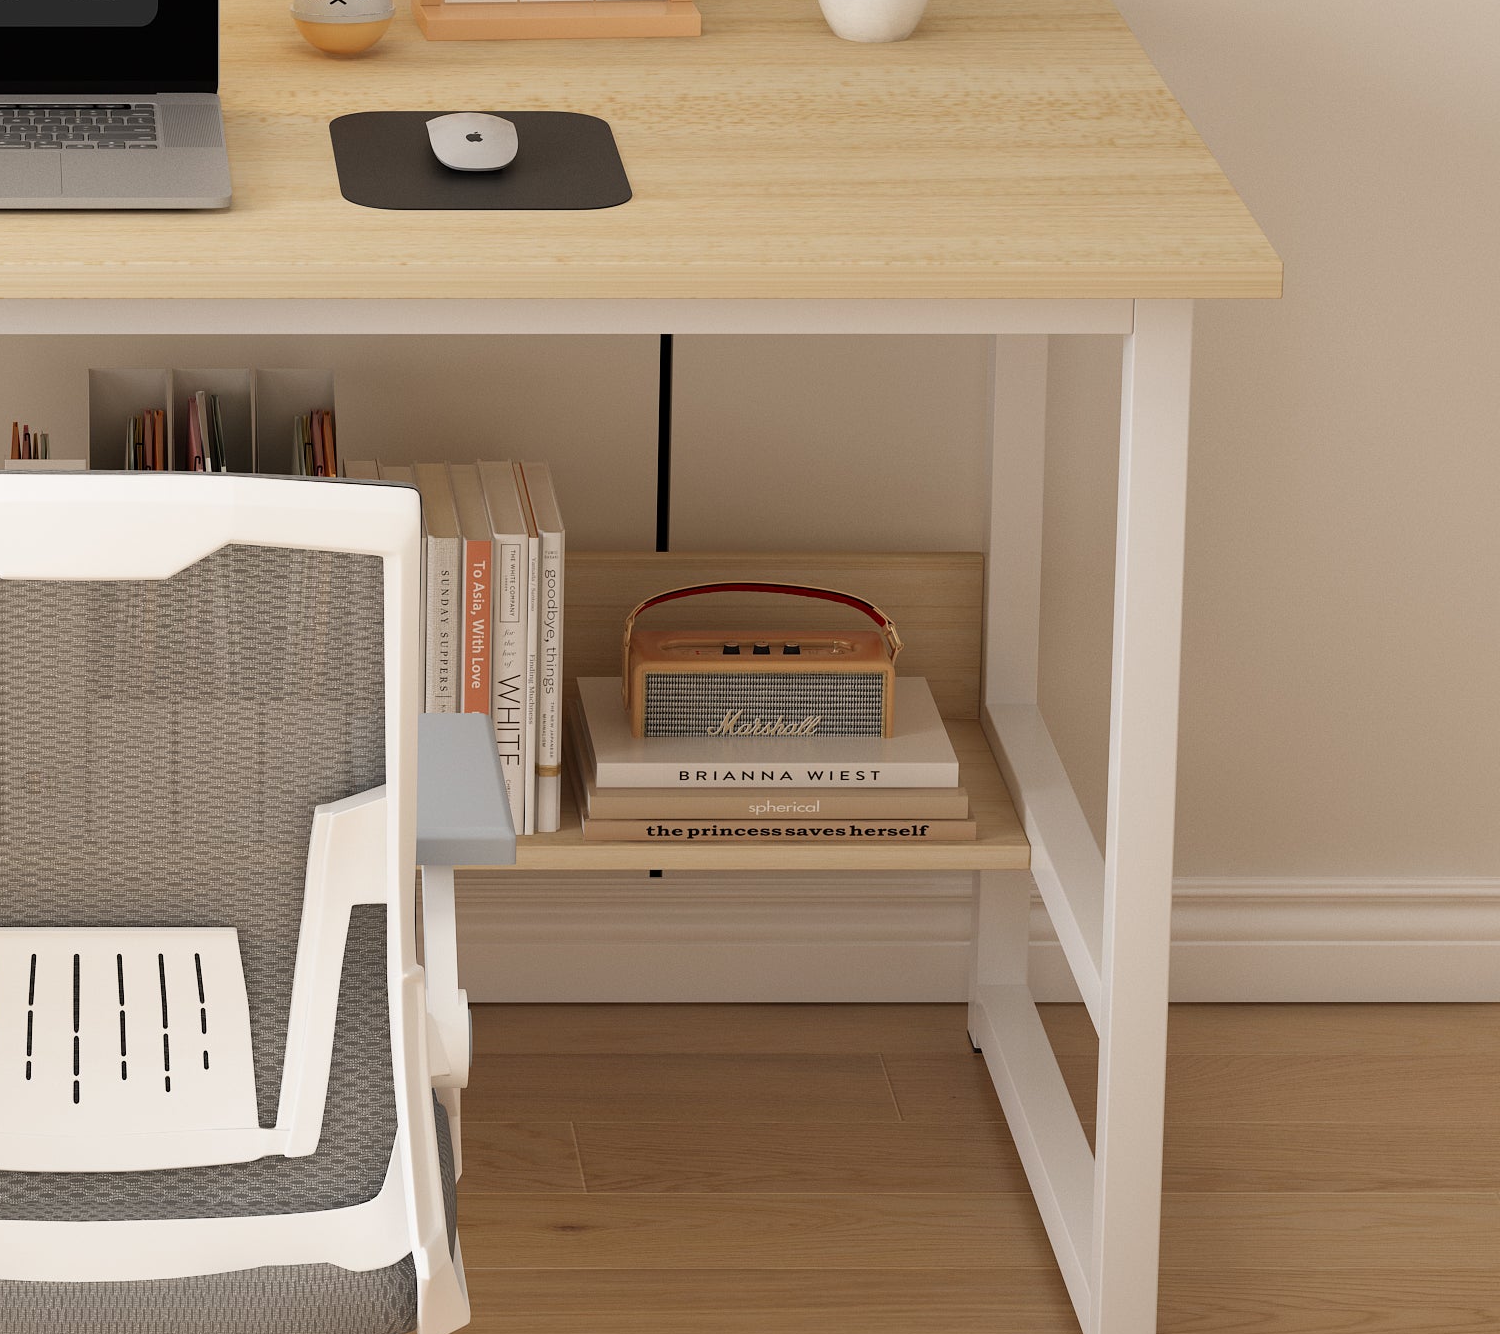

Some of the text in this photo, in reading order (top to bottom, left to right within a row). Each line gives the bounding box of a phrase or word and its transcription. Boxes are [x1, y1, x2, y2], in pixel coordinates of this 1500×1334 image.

[469, 560, 486, 690] To Asia, With Love
[544, 569, 559, 643] goodbye,
[439, 570, 450, 692] SUNDAY SUPPERS
[504, 660, 513, 668] of
[542, 647, 557, 695] things
[527, 654, 536, 725] Finding Muchness
[707, 709, 823, 737] Marshall
[679, 770, 882, 782] BRIANNA WIEST
[748, 799, 821, 816] spherical
